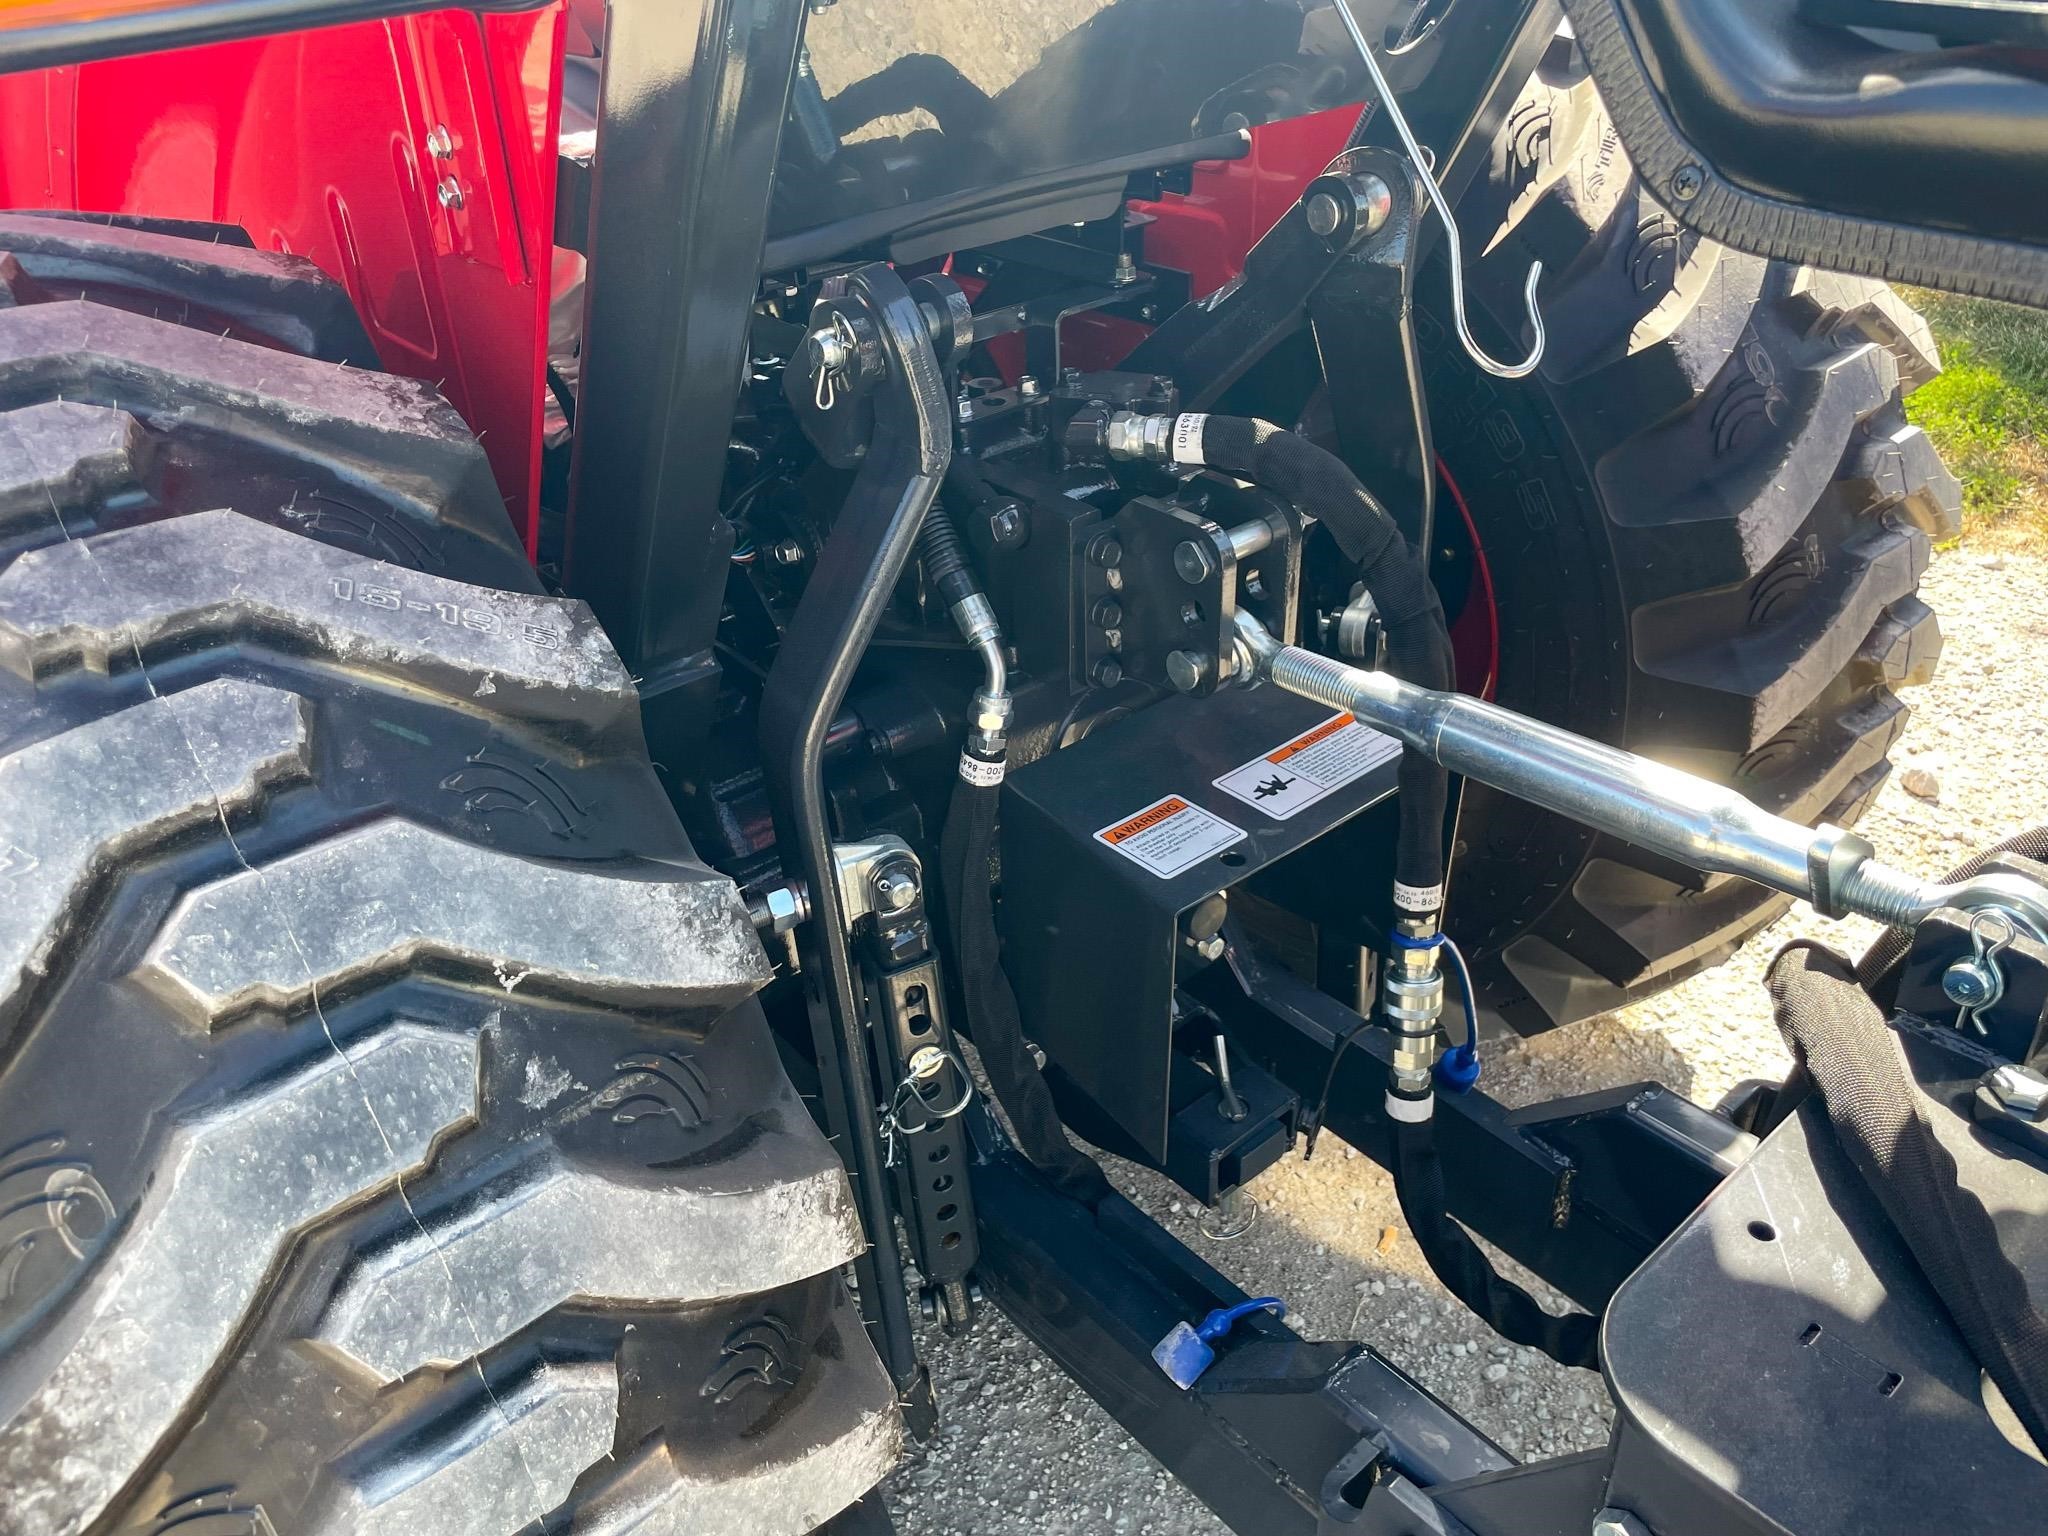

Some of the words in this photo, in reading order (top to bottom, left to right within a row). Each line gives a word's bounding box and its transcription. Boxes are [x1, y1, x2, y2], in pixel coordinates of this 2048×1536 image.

[327, 576, 559, 651] 15-19.5
[1301, 722, 1342, 746] WARNING
[1122, 802, 1179, 835] WARNING
